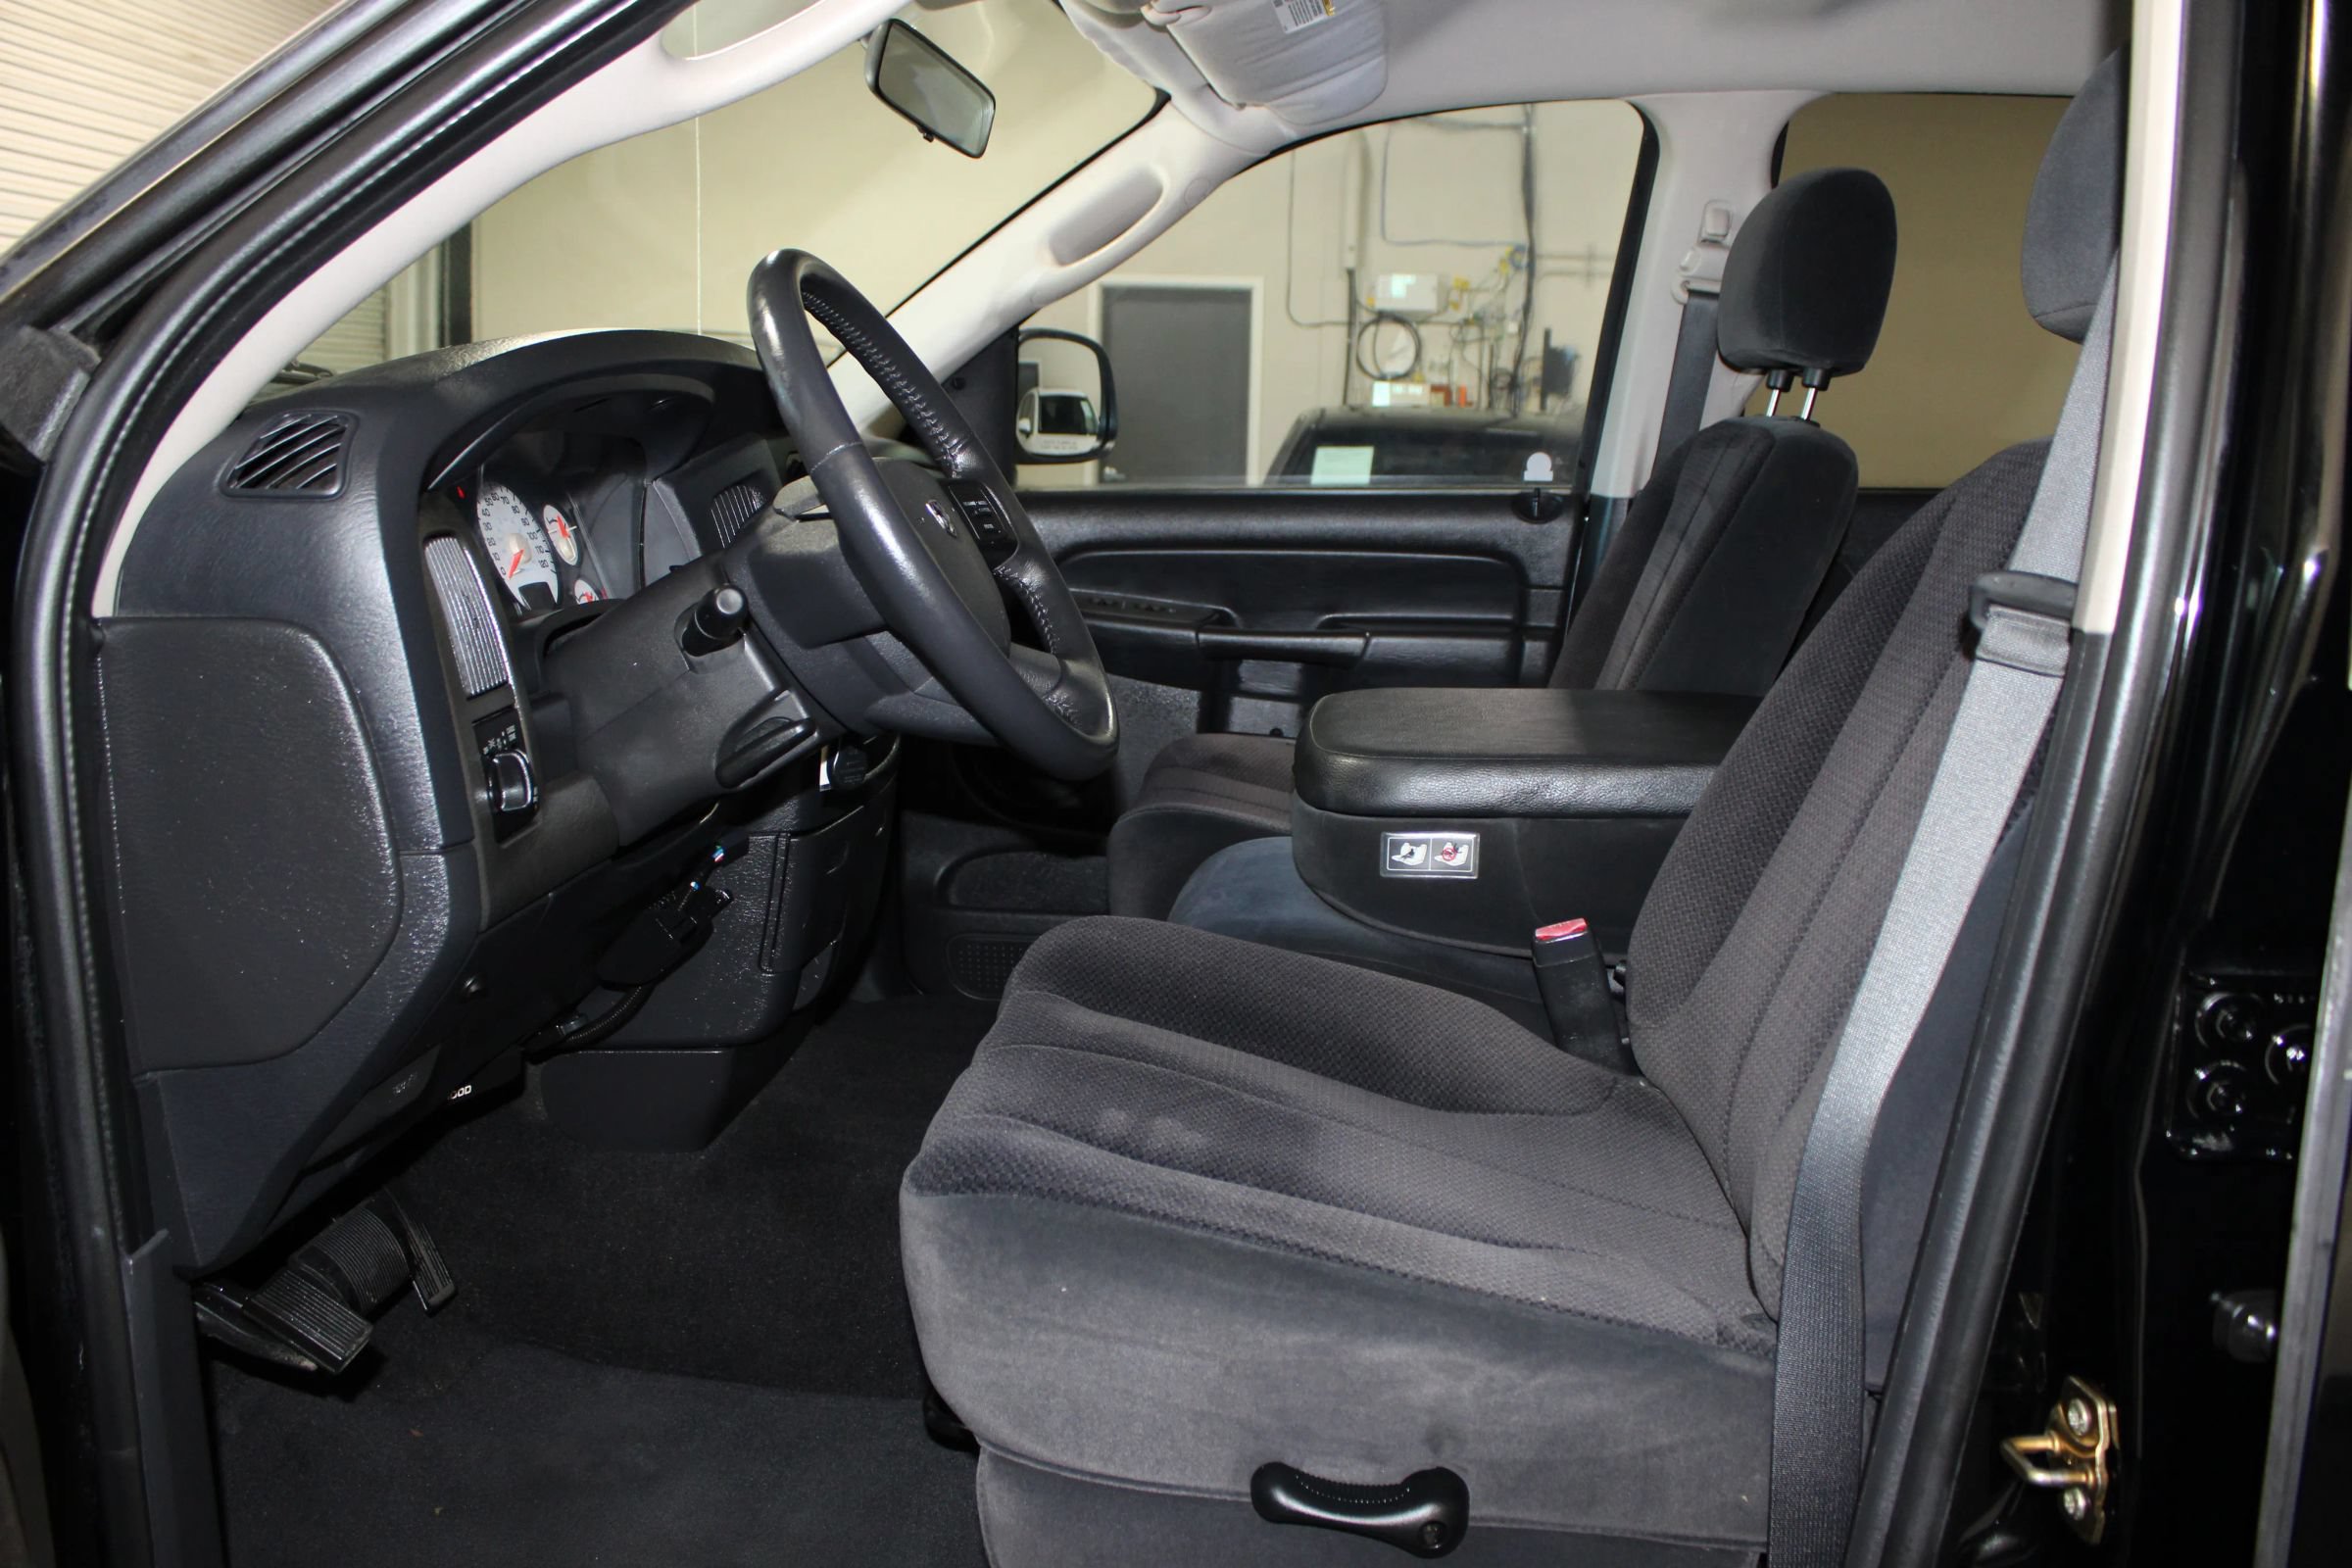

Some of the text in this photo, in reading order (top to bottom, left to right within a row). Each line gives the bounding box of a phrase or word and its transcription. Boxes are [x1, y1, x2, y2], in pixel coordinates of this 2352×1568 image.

[484, 498, 494, 507] 50
[500, 496, 510, 505] 70
[482, 508, 491, 517] 40
[483, 521, 493, 531] 30
[486, 537, 497, 547] 20
[492, 552, 501, 562] 10
[538, 559, 550, 568] 120
[448, 1084, 472, 1101] OOD
